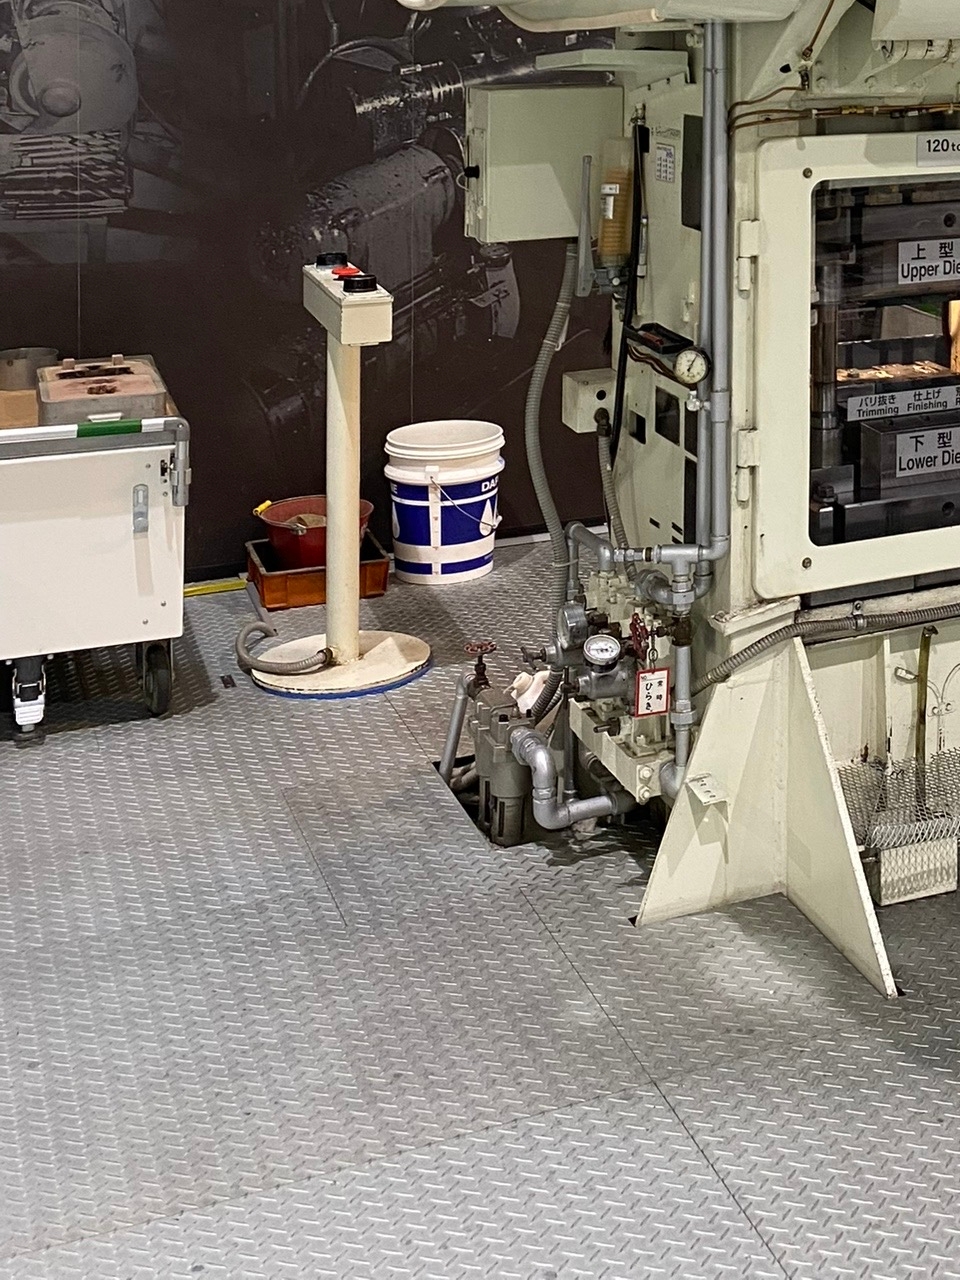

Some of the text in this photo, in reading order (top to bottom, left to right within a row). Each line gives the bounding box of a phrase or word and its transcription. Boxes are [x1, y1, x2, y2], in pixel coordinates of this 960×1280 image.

[901, 263, 939, 282] Upper
[859, 394, 897, 407] バリ抜き
[913, 388, 942, 401] 仕上げ
[856, 405, 900, 418] Trimming
[907, 399, 948, 412] Finishing
[898, 456, 938, 472] Lower
